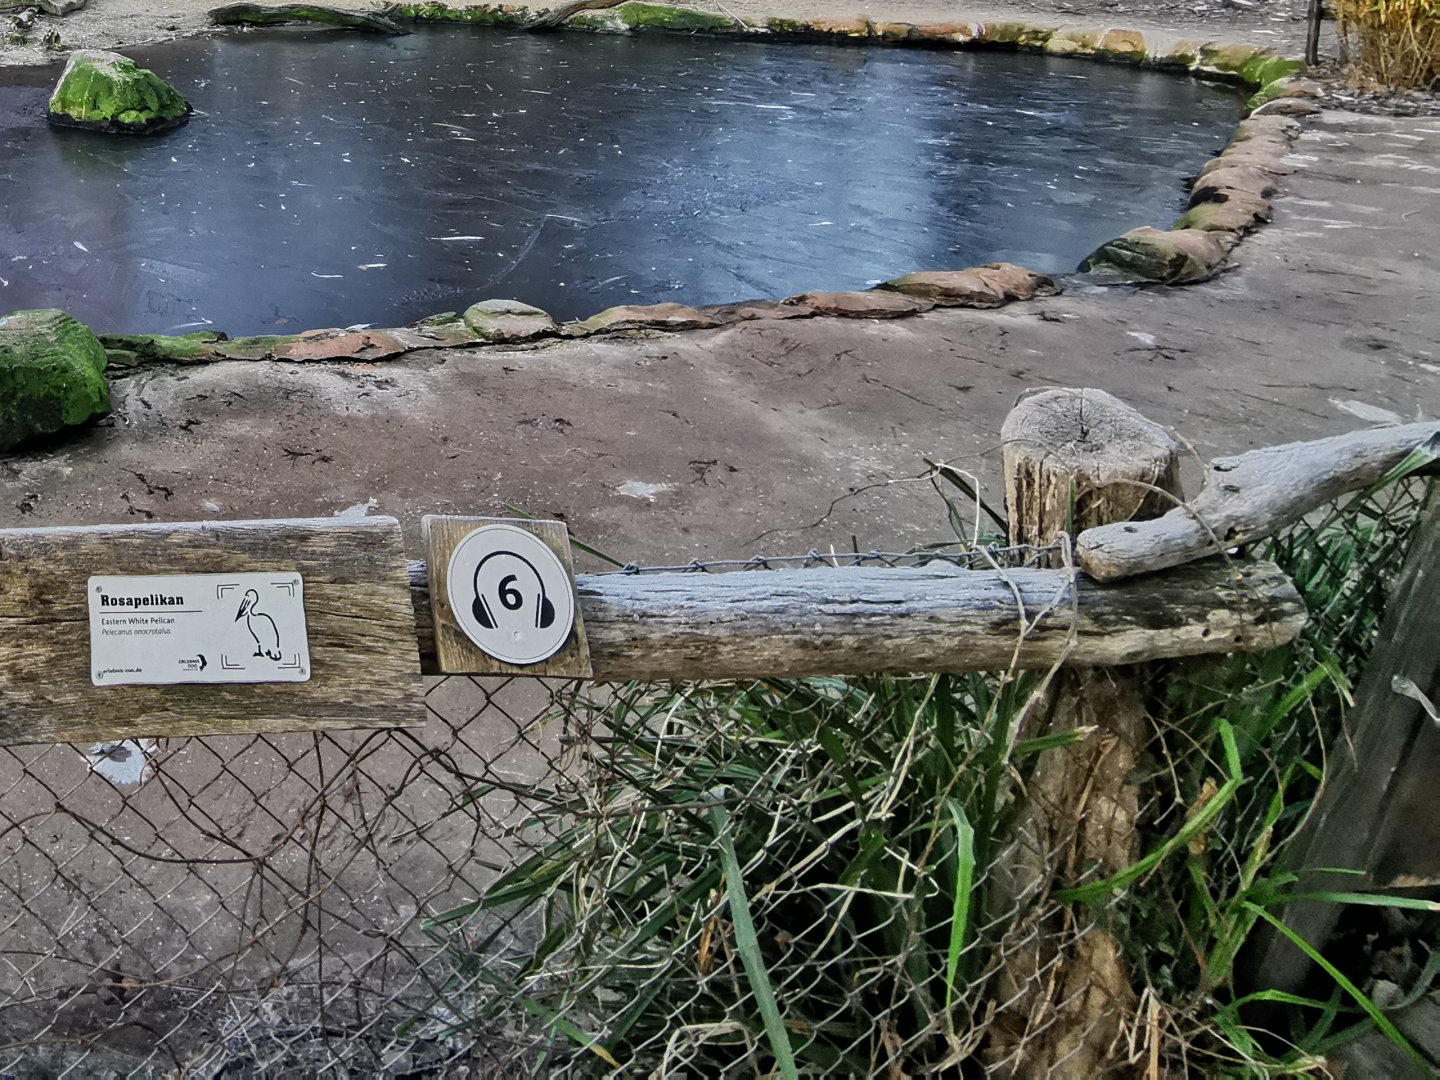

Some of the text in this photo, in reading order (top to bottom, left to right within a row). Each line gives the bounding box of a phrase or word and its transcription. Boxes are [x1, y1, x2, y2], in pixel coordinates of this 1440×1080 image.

[498, 574, 523, 611] 6
[100, 593, 184, 609] Rosapelikan
[101, 616, 175, 626] Eastern White Pelican
[101, 627, 171, 636] Pelecanus onocrotalus
